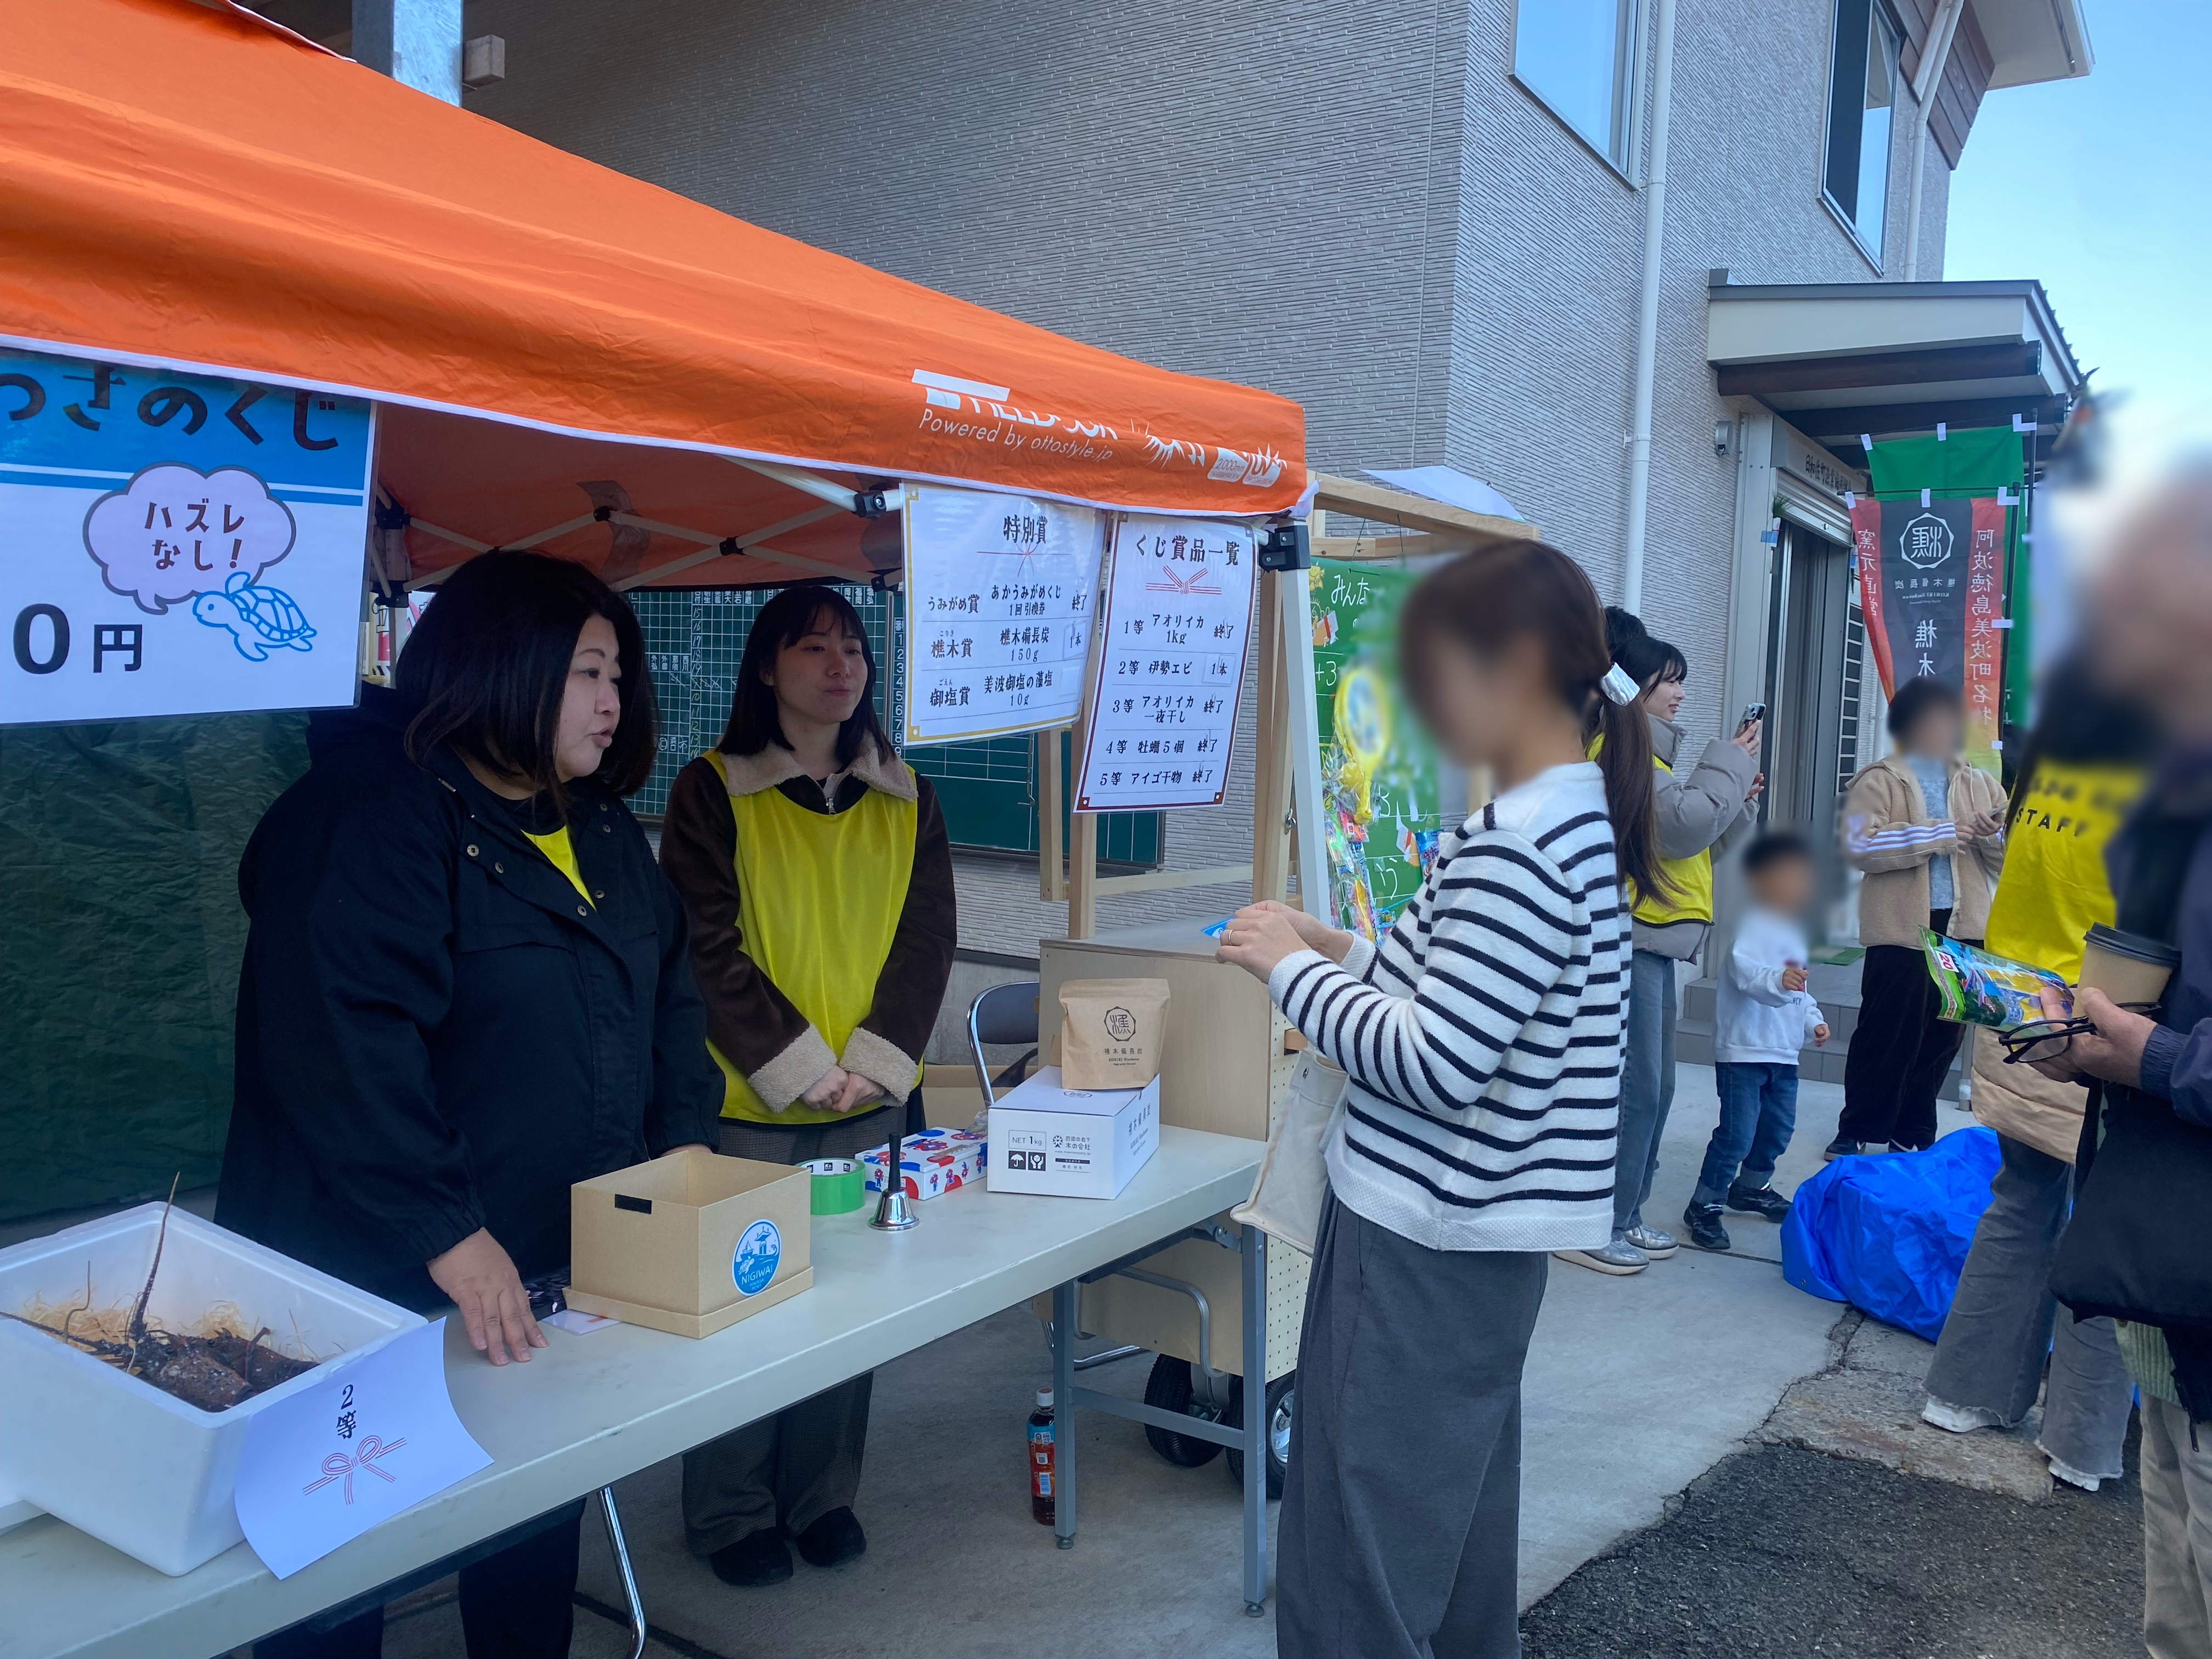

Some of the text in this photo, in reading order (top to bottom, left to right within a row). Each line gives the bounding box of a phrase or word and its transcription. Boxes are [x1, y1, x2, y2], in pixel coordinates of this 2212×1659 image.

[919, 408, 1001, 442] Powered
[1004, 424, 1026, 451] by
[1031, 436, 1113, 462] ottostyle.jp
[144, 498, 245, 534] ハズレ
[1003, 514, 1048, 545] 特別賞
[152, 538, 242, 571] なし!
[1137, 534, 1240, 566] くじ賞品一覧
[928, 583, 1087, 613] うみがめ賞 あかうみがめくじ 終了
[1009, 601, 1045, 616] 1回引換券
[1125, 614, 1233, 639] 1等 アオリイカ 終了
[13, 603, 143, 675] 0円
[898, 634, 902, 646] 1
[931, 638, 973, 658] 樵木賞
[1000, 627, 1049, 646] 樵木備長炭
[1167, 630, 1187, 644] 1kg
[897, 648, 903, 660] 2
[1011, 648, 1039, 662] 150g
[896, 662, 903, 673] 3
[1118, 660, 1228, 675] 2等 伊勢エビ 1本
[896, 676, 903, 687] 4
[929, 670, 1053, 707] 御塩賞 美波御塩の藻塩
[896, 691, 903, 702] 5
[1011, 693, 1029, 706] 10g
[1113, 695, 1223, 713] 3等 アオリイカ 終了
[895, 705, 903, 716] 6
[1144, 709, 1186, 724] 一夜干し
[691, 721, 699, 731] 12
[895, 719, 902, 730] 7
[895, 732, 902, 743] 8
[1106, 739, 1127, 754] 4等
[1197, 738, 1217, 753] 終了
[1100, 769, 1213, 786] 5等 アイゴ干物 終了
[1348, 825, 1353, 833] 19
[1939, 953, 1954, 971] 20
[1065, 1142, 1091, 1150] 木の会社
[741, 1264, 773, 1284] NIGIWAI
[336, 1384, 357, 1440] 2等
